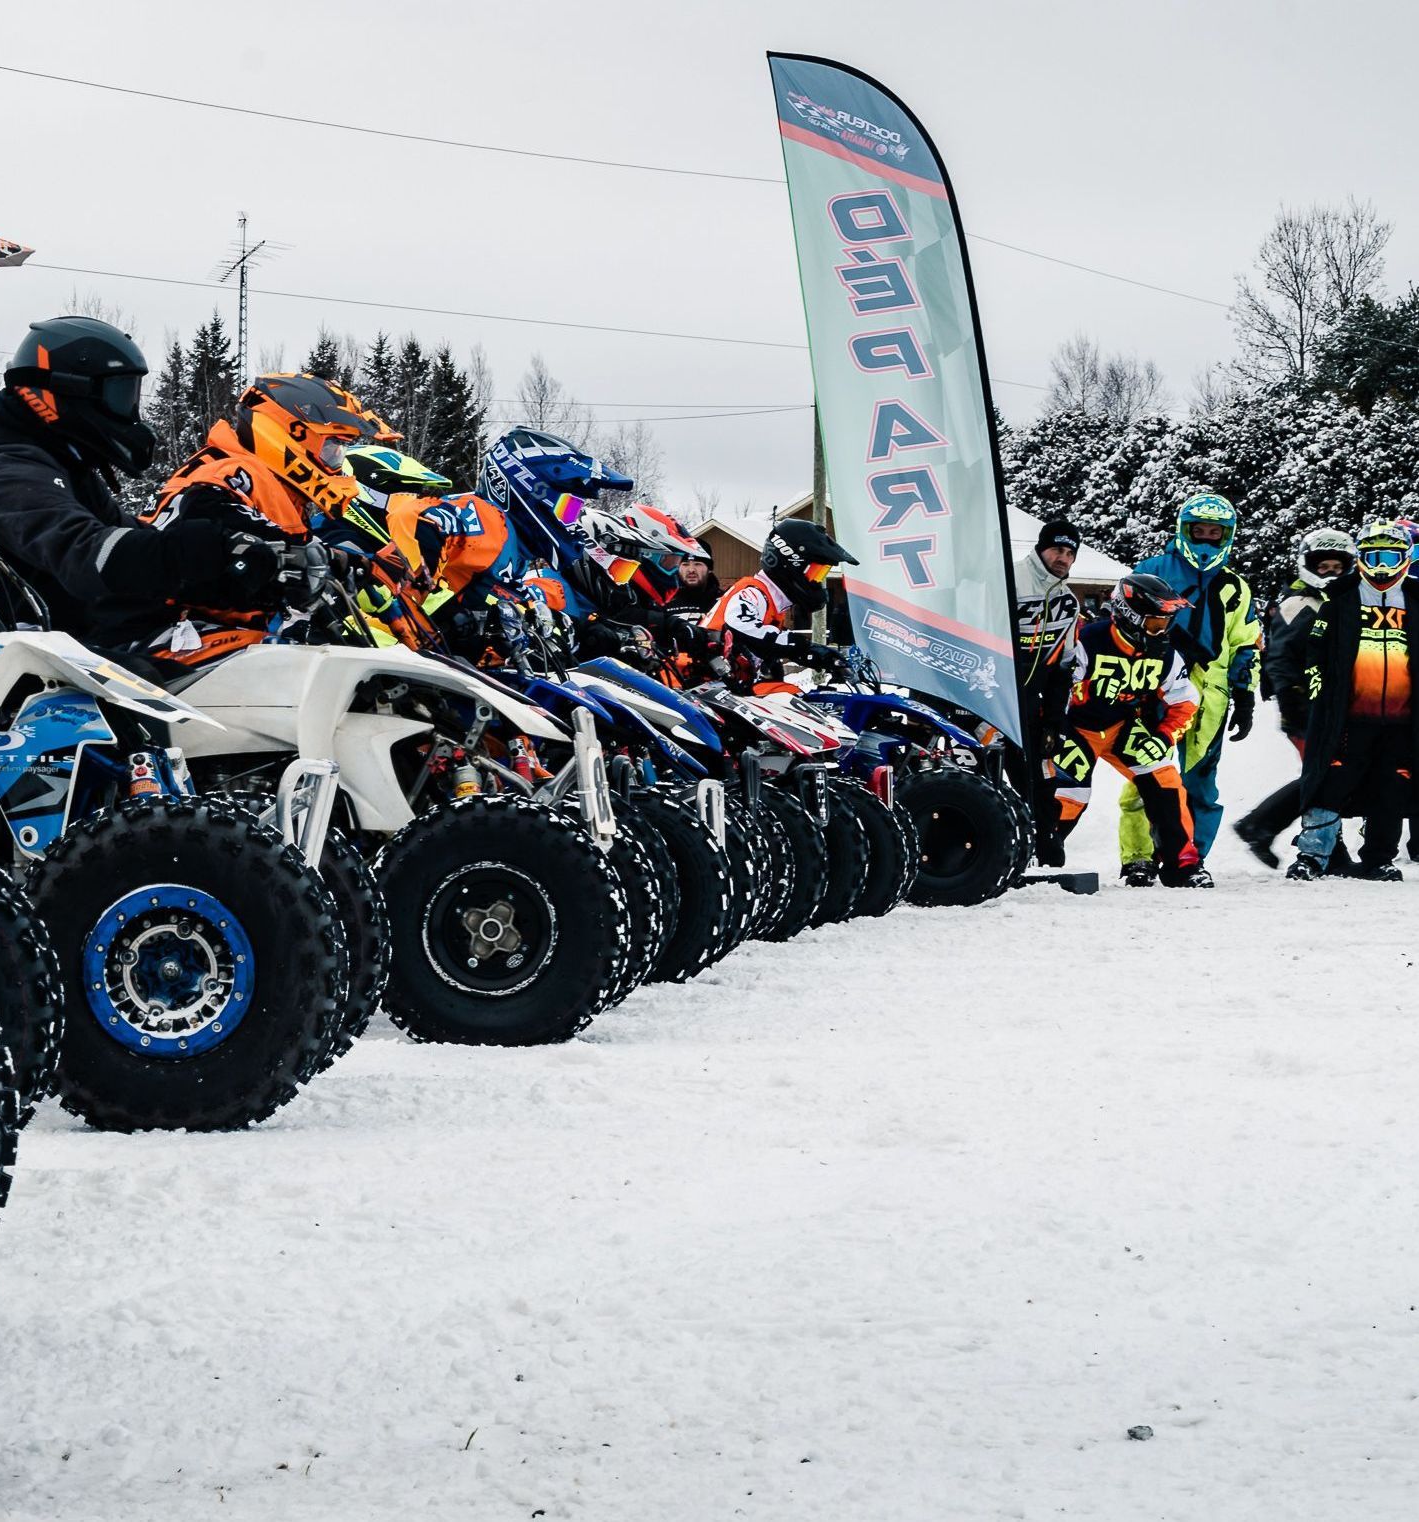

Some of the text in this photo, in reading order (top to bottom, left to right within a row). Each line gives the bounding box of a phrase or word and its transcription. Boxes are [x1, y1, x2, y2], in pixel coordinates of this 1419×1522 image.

[13, 385, 60, 424] HOR
[770, 533, 805, 567] 100%
[1091, 654, 1164, 691] FXR
[23, 765, 60, 775] paysager
[26, 754, 76, 763] FILS
